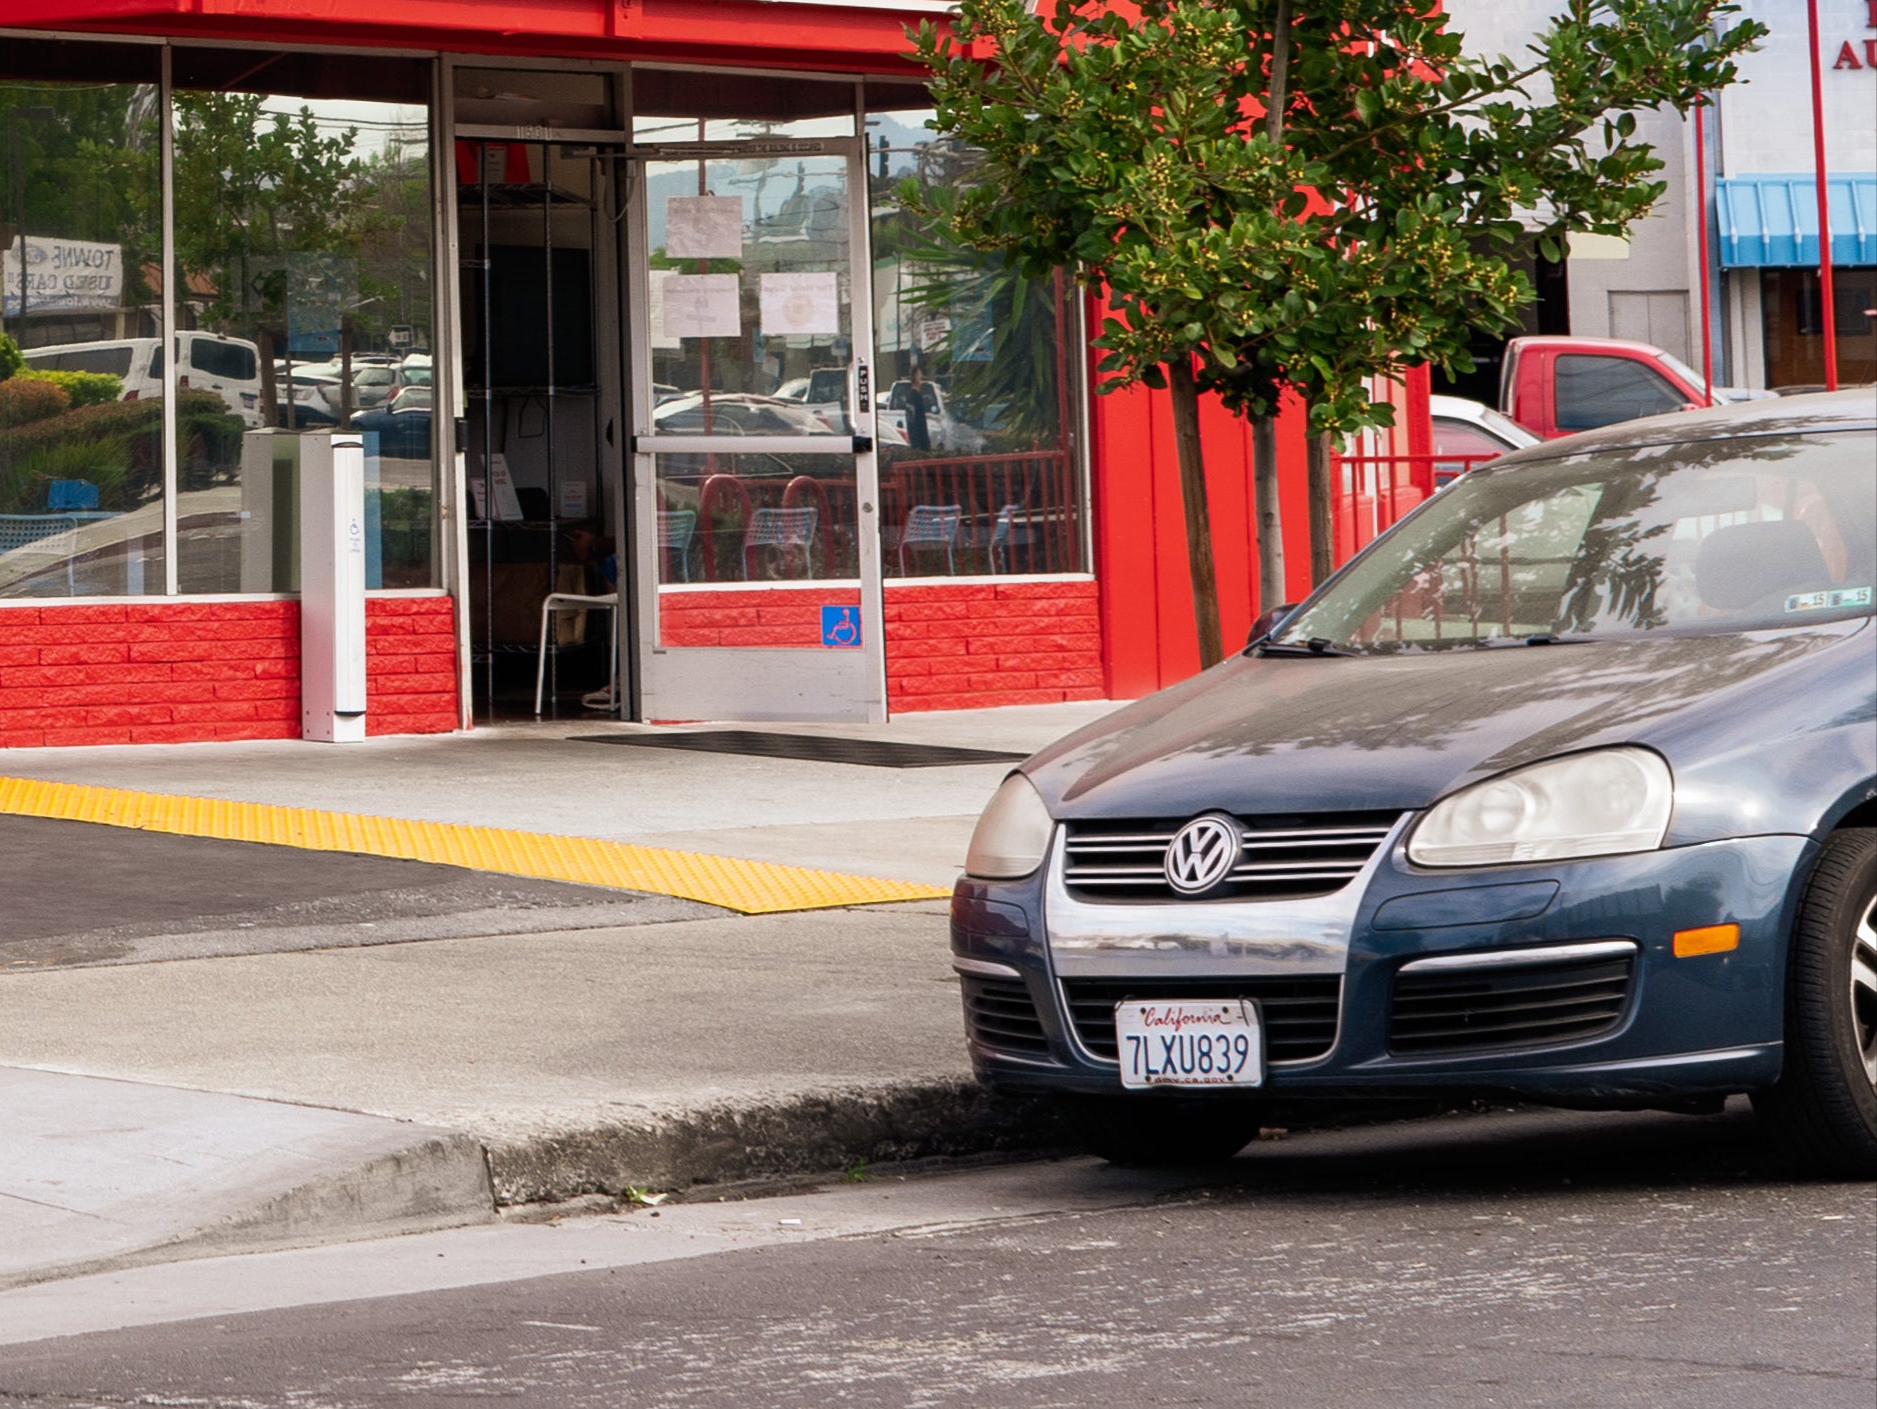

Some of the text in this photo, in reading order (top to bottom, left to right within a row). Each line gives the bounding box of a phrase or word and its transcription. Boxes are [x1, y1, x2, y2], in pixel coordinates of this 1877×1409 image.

[859, 369, 868, 401] PUSH
[1144, 1007, 1231, 1032] California
[1126, 1034, 1249, 1075] 7LXU839
